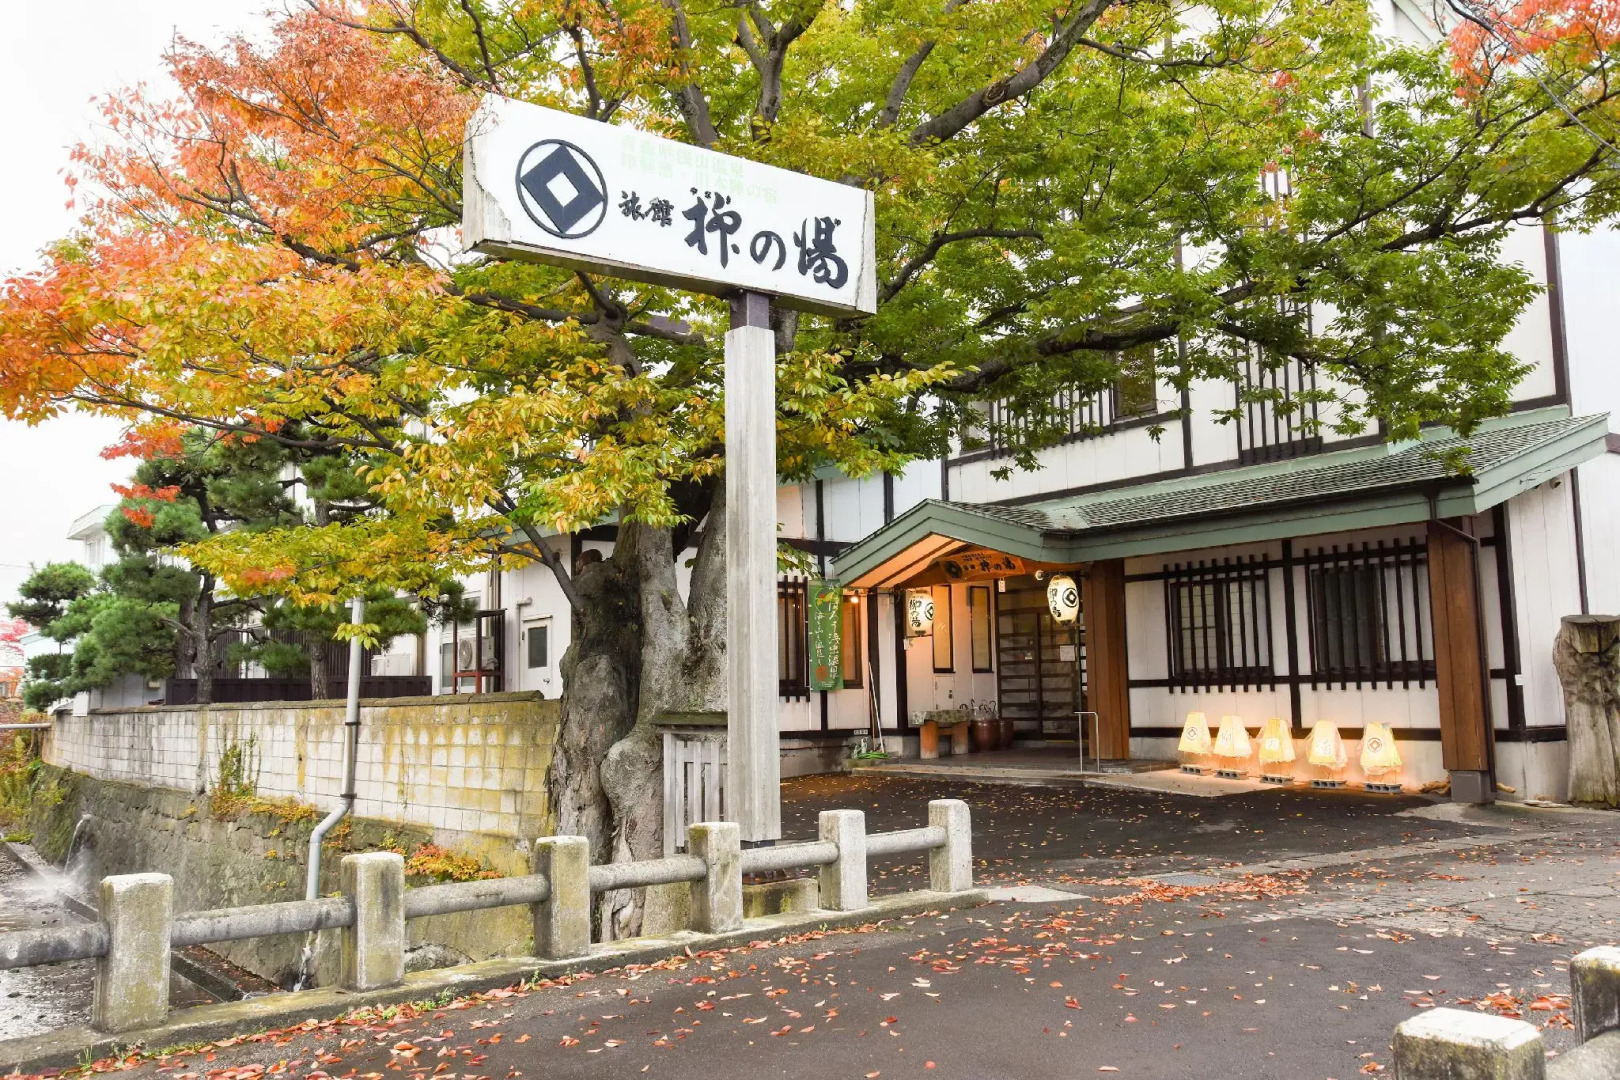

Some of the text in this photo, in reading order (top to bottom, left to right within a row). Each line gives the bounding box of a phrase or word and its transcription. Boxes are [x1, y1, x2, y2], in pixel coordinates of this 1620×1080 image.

[618, 190, 849, 290] 旅館 柳の湯
